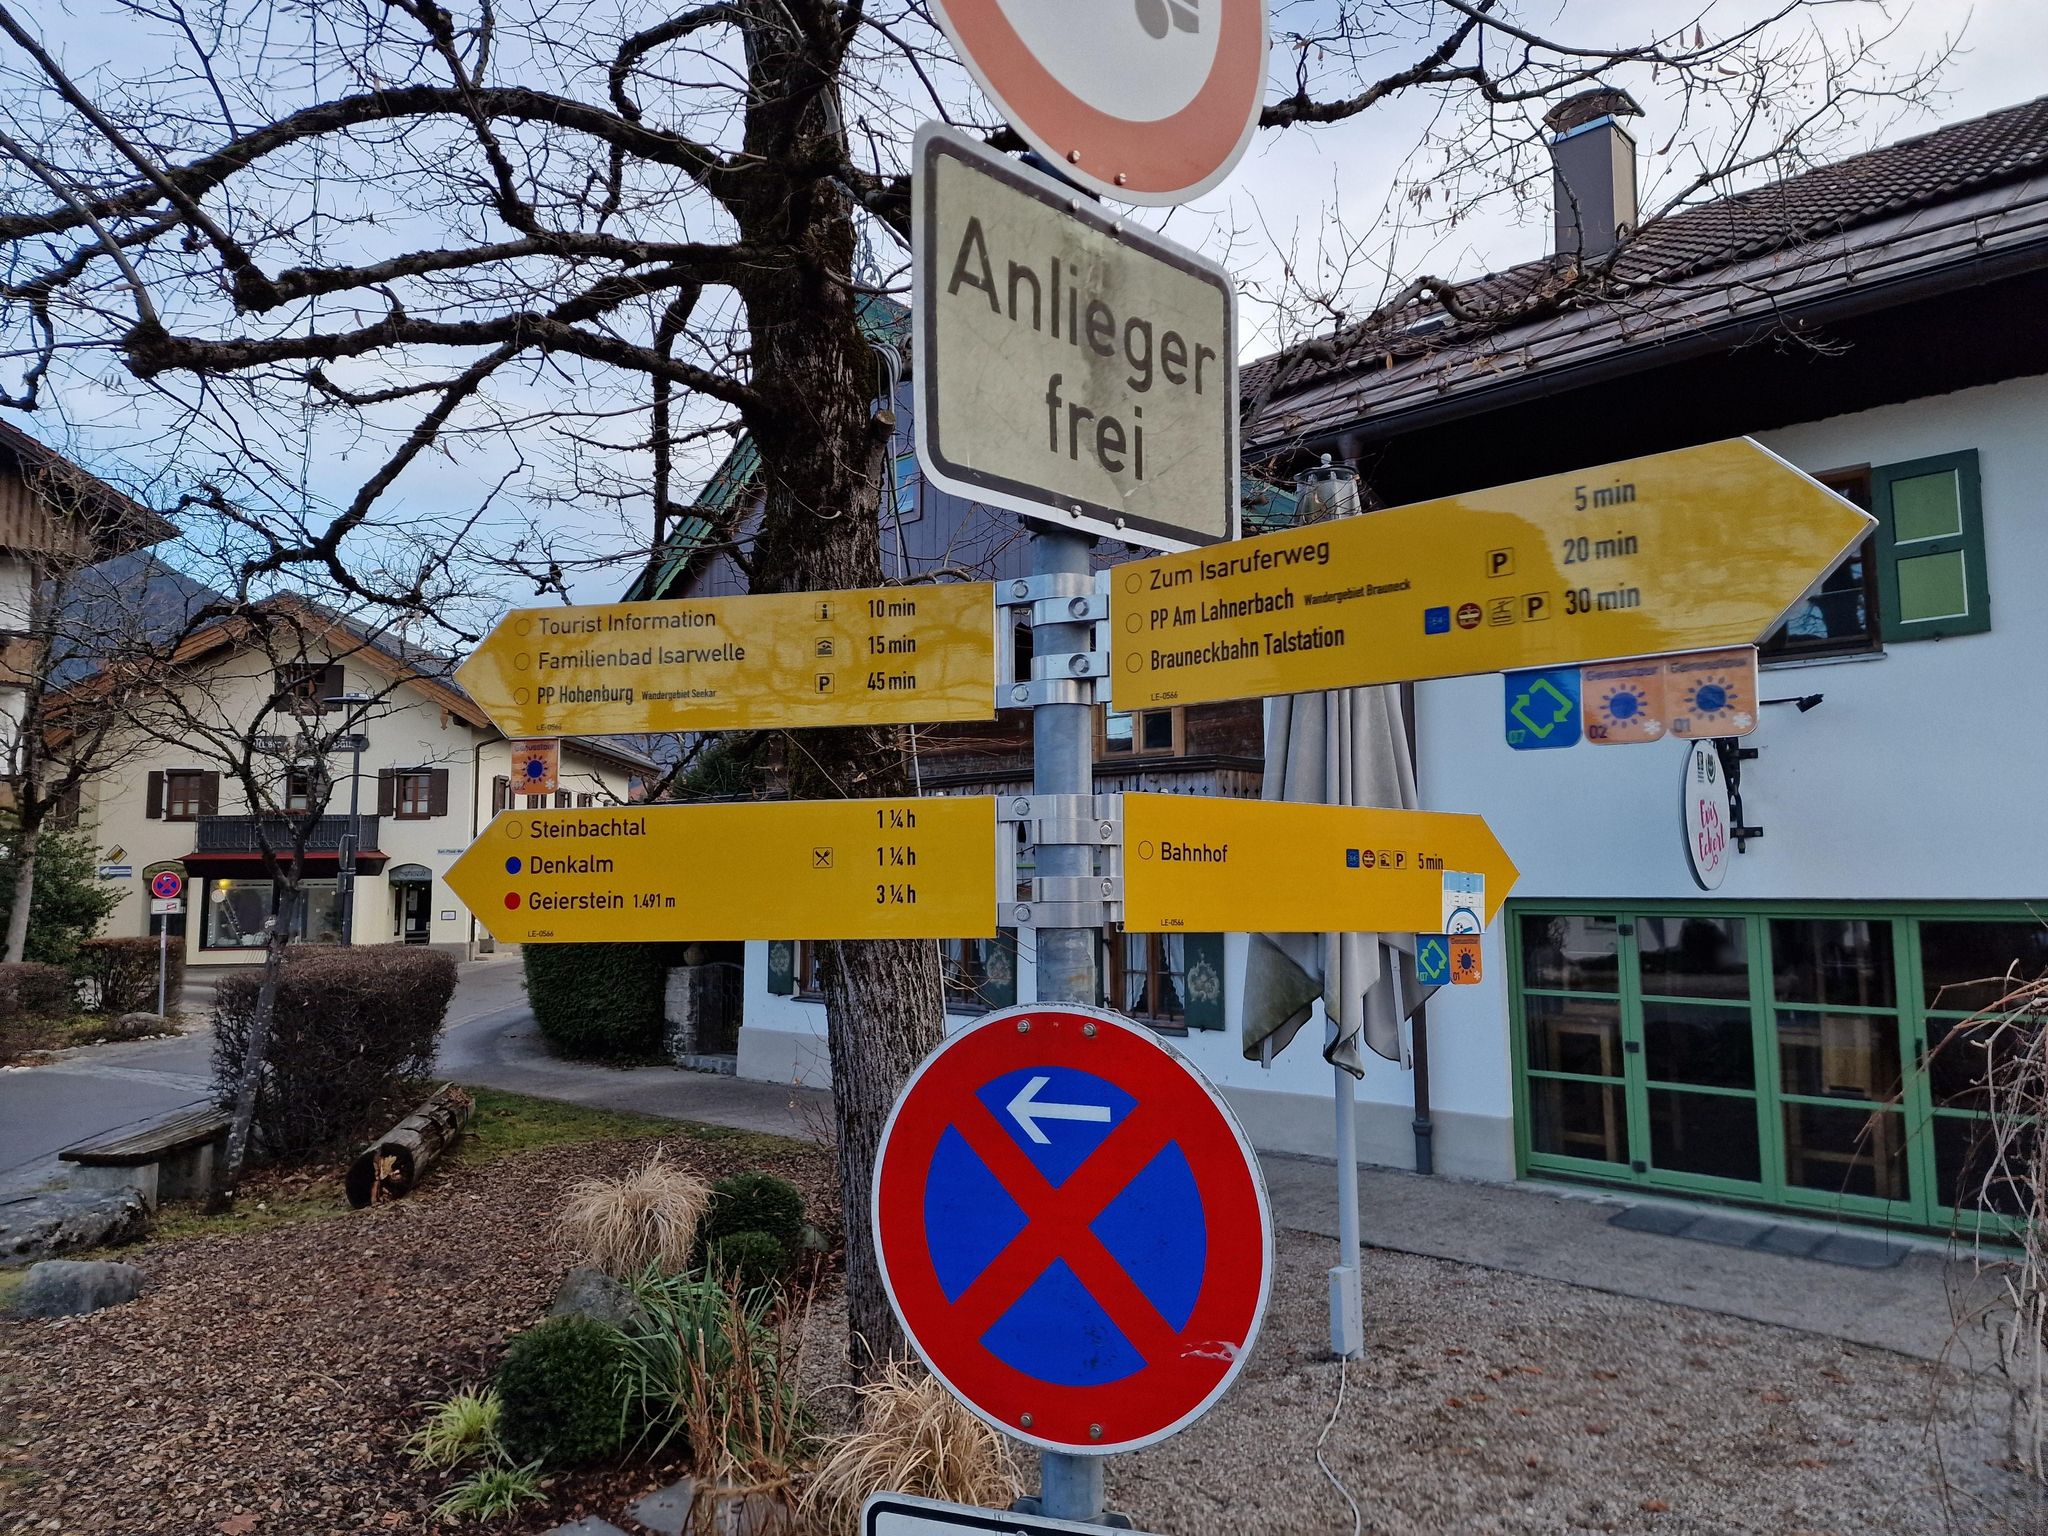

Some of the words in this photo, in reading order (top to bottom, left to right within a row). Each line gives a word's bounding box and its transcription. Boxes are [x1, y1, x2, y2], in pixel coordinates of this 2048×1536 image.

[947, 215, 1217, 395] Anlieger
[1045, 372, 1143, 480] frei
[1575, 485, 1587, 511] 5
[1593, 479, 1636, 509] min
[1563, 536, 1589, 565] 20
[1595, 530, 1638, 559] min
[1150, 567, 1193, 590] Zum
[1200, 541, 1330, 582] Isaruferweg
[868, 599, 884, 618] 10
[889, 598, 916, 617] min
[1150, 610, 1168, 631] PP
[1173, 605, 1196, 627] Am
[1201, 587, 1294, 622] Lahnerbach
[1565, 587, 1590, 615] 30
[1597, 582, 1641, 611] min
[539, 615, 602, 635] Tourist
[608, 610, 716, 632] Information
[868, 636, 885, 655] 15
[889, 635, 916, 654] min
[1151, 637, 1259, 671] Brauneckbahn
[1264, 626, 1345, 656] Talstation
[538, 647, 651, 670] Familienbad
[659, 643, 745, 665] Isarwelle
[867, 672, 885, 690] 45
[889, 671, 916, 689] min
[537, 686, 555, 704] PP
[560, 685, 634, 705] Hohenburg
[642, 690, 690, 701] Wandergebiet
[691, 689, 717, 698] Seekar
[1589, 725, 1608, 739] 02
[530, 817, 646, 839] Steinbachtal
[907, 810, 916, 829] h
[907, 847, 916, 866] h
[1160, 841, 1228, 863] Bahnhof
[530, 855, 614, 875] Denkalm
[529, 891, 624, 910] Geierstein
[633, 893, 661, 908] 1.491
[665, 897, 676, 908] m
[907, 884, 916, 904] h
